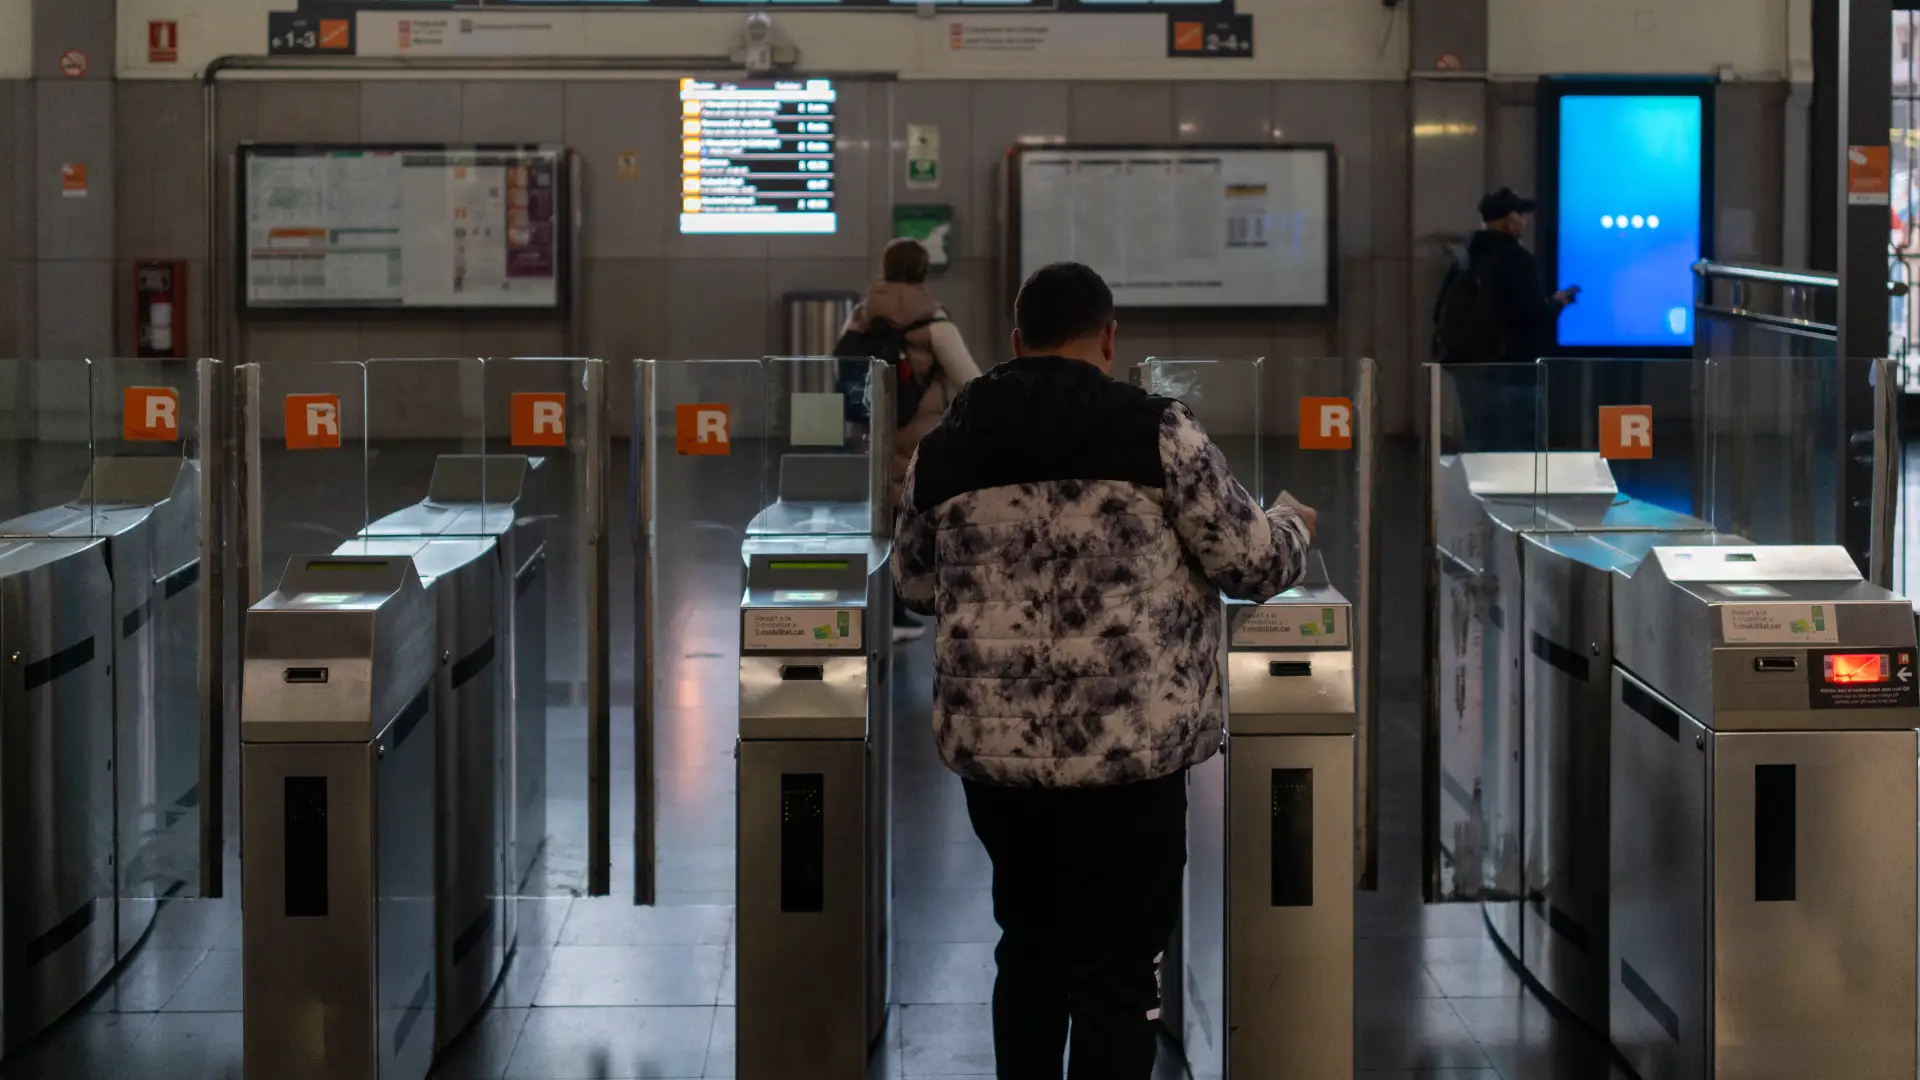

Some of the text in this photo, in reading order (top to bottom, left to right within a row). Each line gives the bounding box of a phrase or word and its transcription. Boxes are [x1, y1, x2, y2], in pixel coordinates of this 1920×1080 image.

[146, 396, 175, 428] R
[307, 402, 337, 435] R
[533, 402, 563, 433] R
[697, 410, 727, 442] R
[1320, 405, 1350, 437] R
[1620, 414, 1650, 446] R
